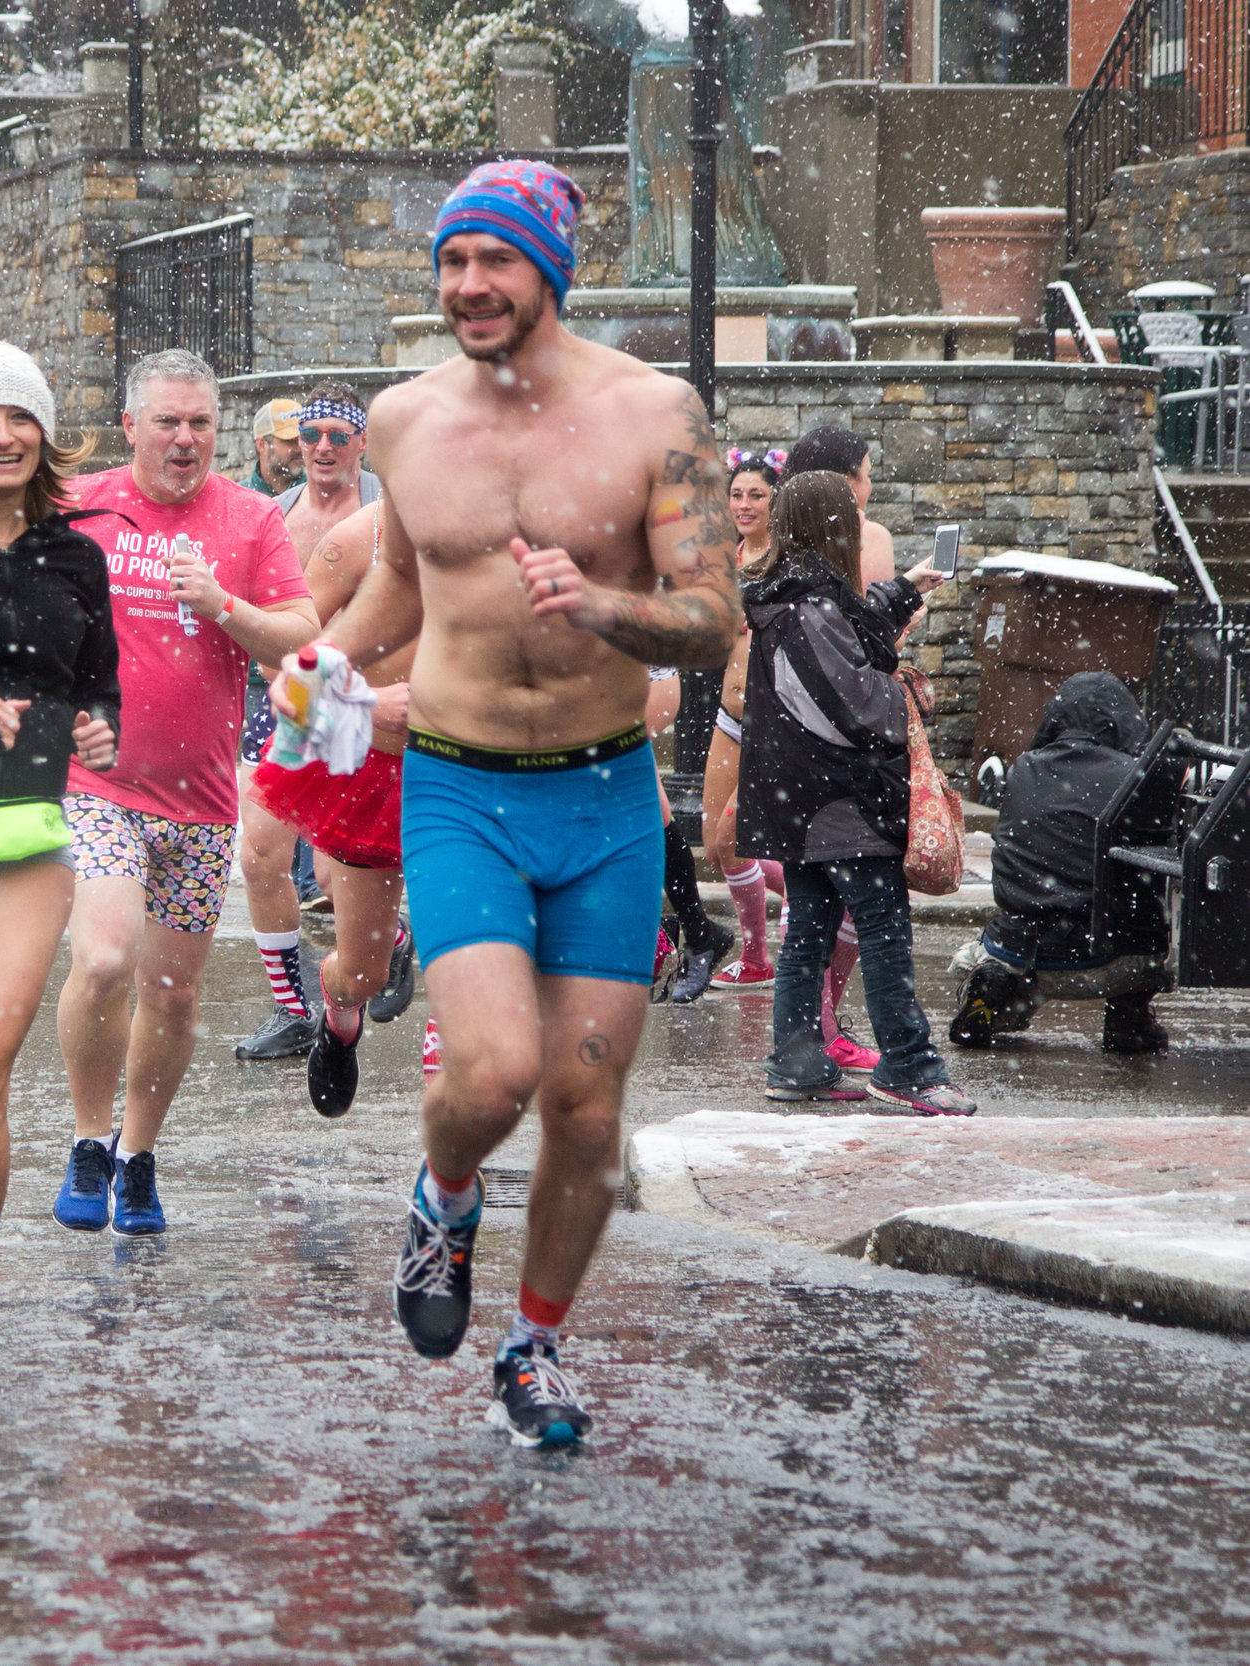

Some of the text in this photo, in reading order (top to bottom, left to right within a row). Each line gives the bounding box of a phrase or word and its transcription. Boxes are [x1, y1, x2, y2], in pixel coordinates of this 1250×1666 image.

[116, 531, 206, 560] NO PANS.
[127, 607, 179, 620] 2018 CINCINNA
[416, 736, 461, 758] HANES
[516, 754, 568, 767] HANES
